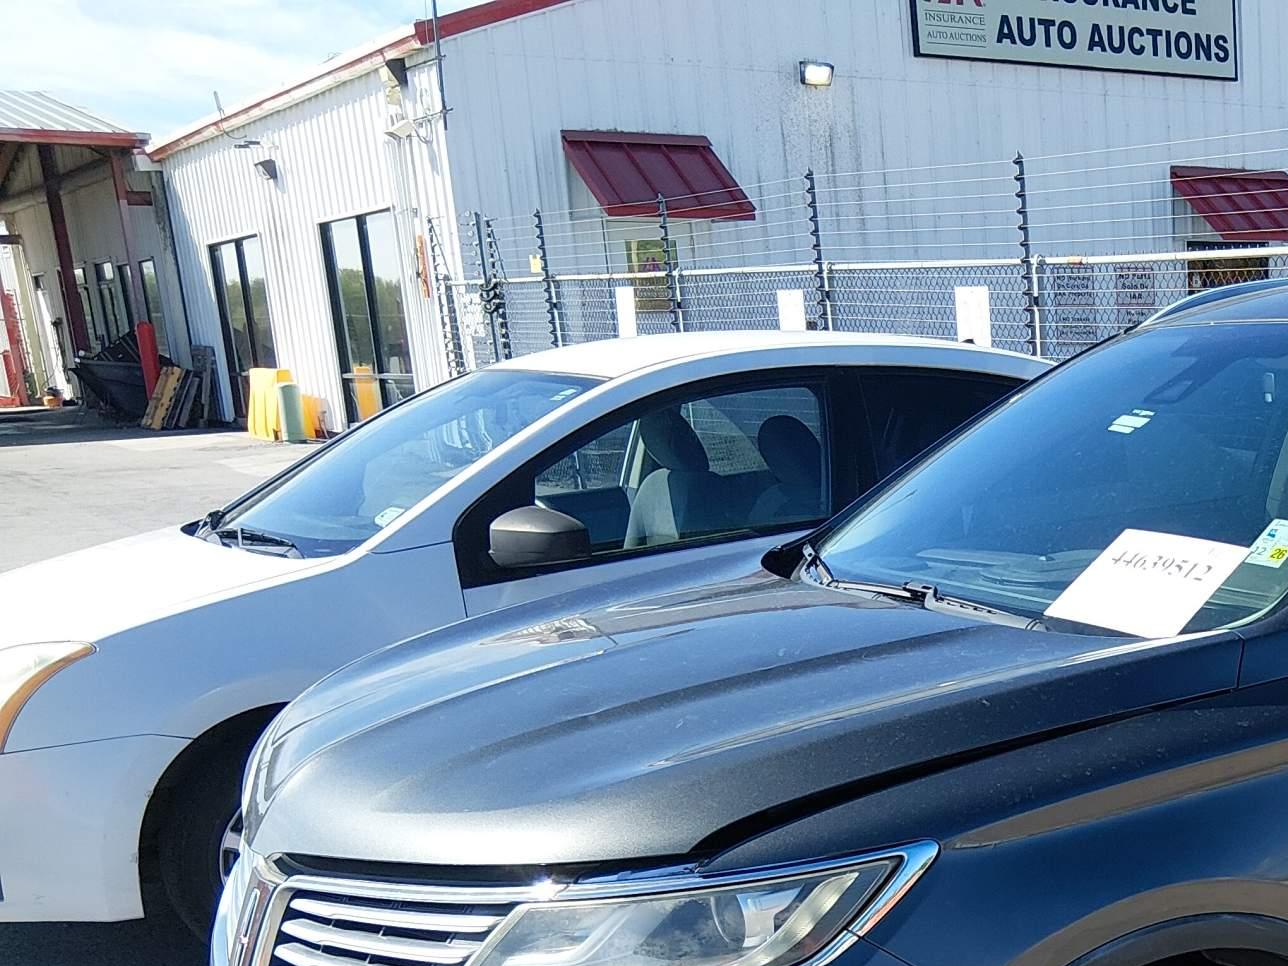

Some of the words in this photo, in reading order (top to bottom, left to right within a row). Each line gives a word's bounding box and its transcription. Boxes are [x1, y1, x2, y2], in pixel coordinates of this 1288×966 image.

[924, 12, 985, 26] INSURANCE
[927, 30, 949, 40] AUTO
[949, 31, 987, 43] AUCTIONS
[996, 14, 1078, 50] AUTO
[1087, 23, 1230, 63] AUCTIONS
[1269, 548, 1288, 560] 26
[1112, 551, 1213, 582] 44639512
